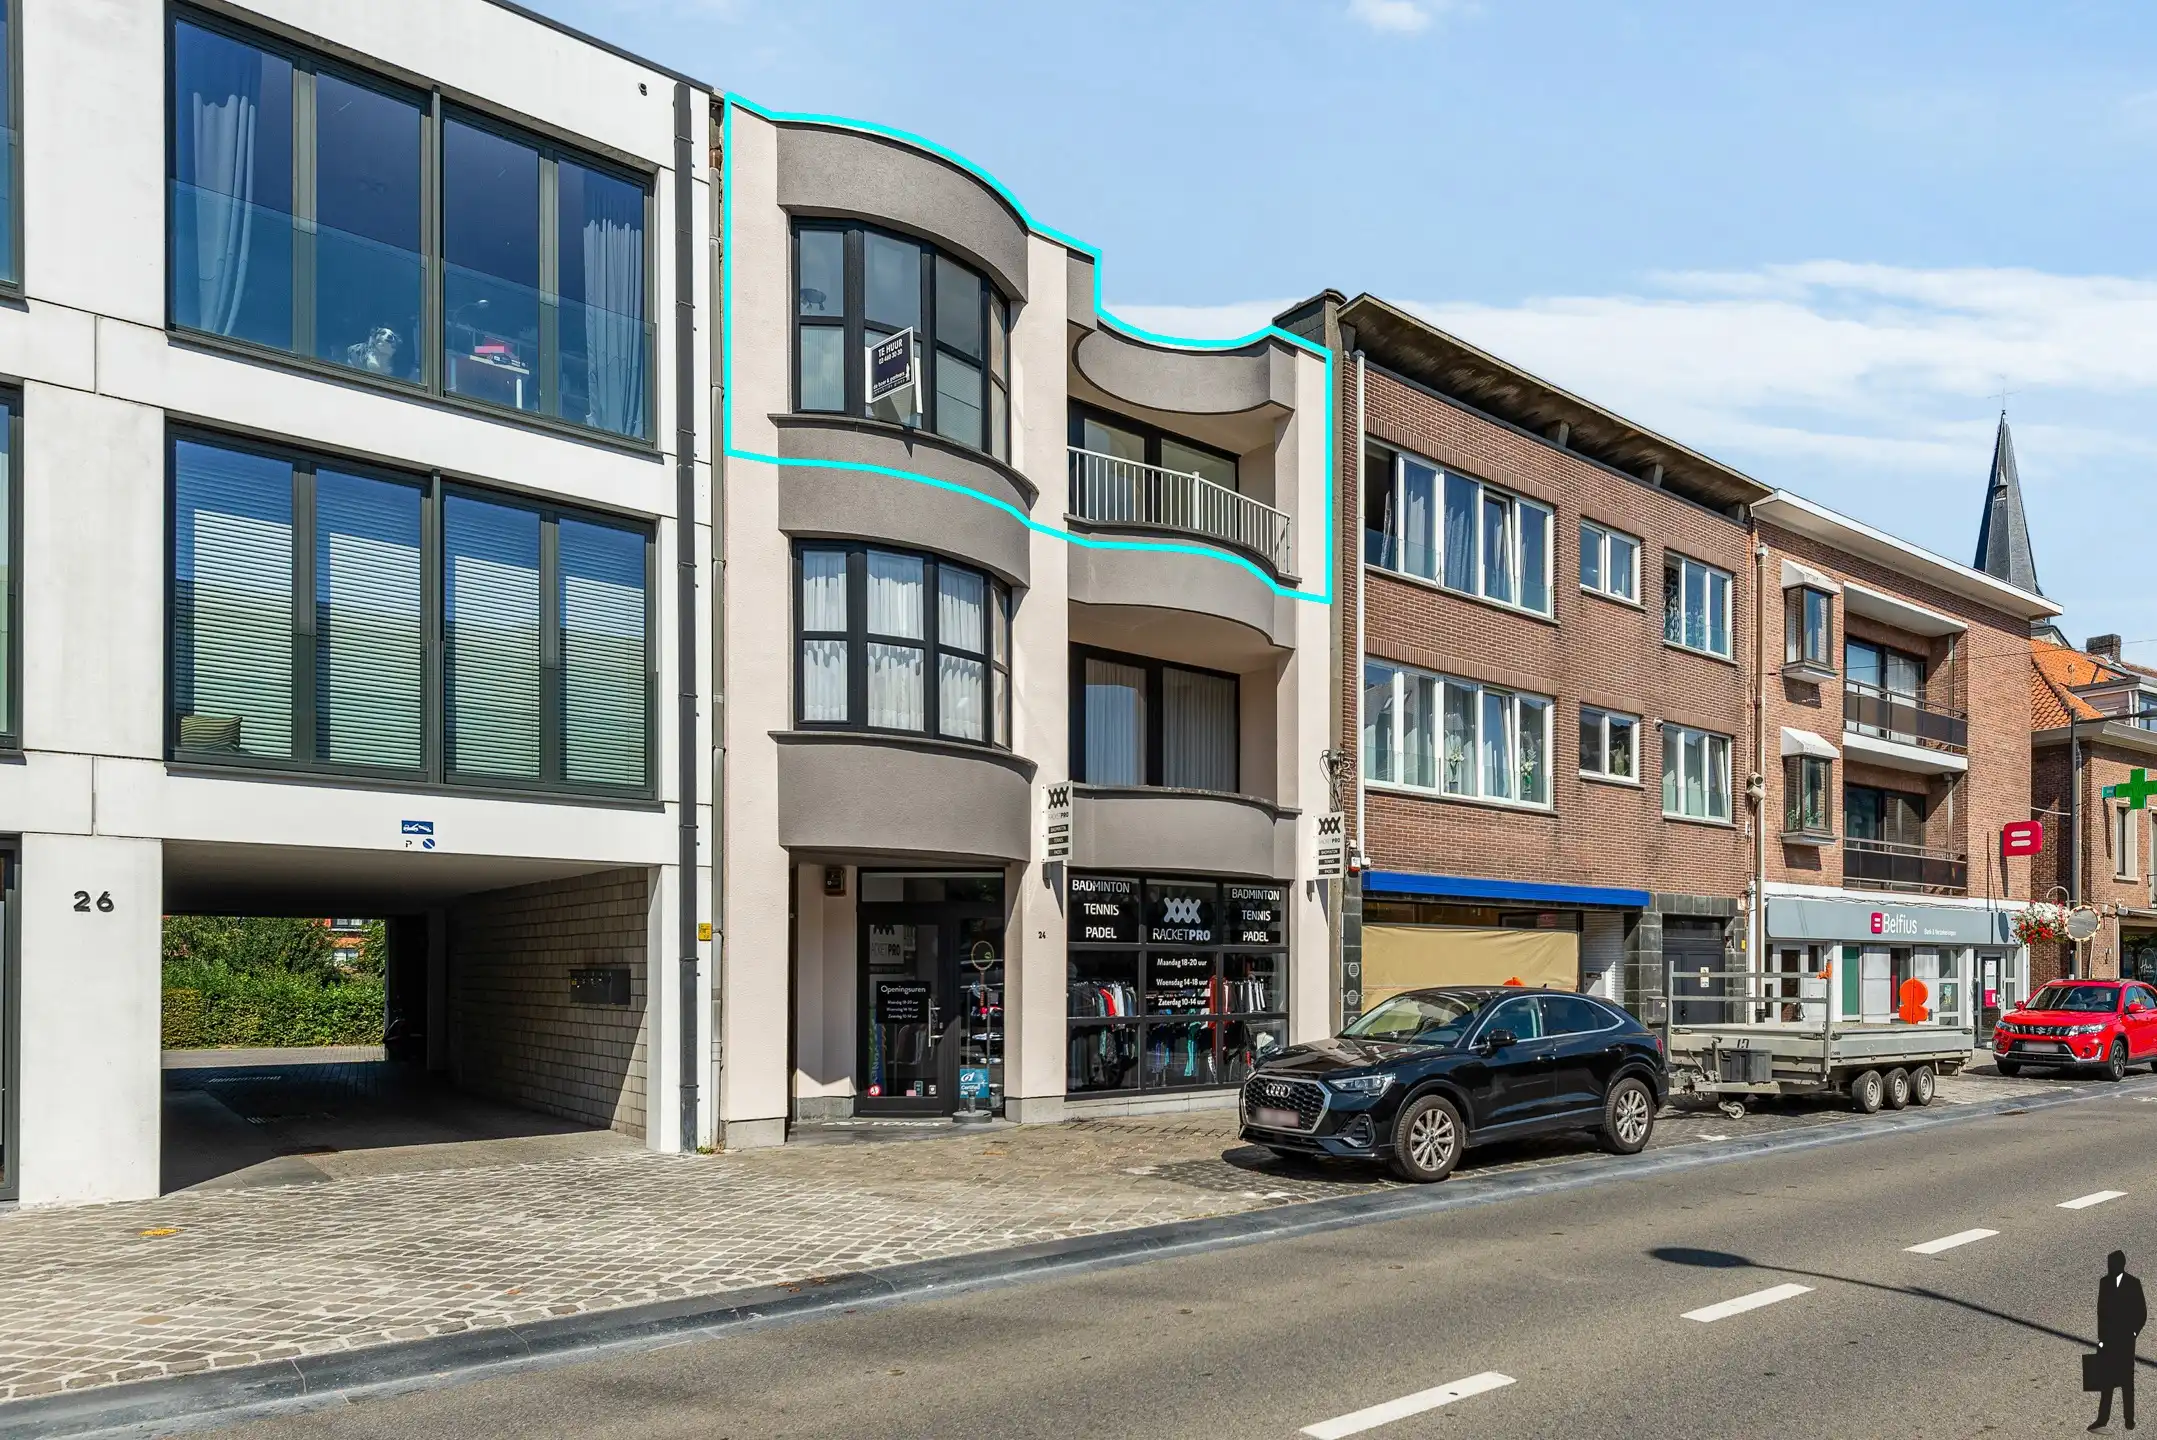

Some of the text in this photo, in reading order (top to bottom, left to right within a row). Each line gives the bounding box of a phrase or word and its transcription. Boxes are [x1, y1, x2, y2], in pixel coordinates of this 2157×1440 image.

[878, 338, 903, 358] TE HUUR
[1072, 879, 1130, 894] BADMINTON
[1231, 888, 1280, 901] BADMINTON
[73, 890, 115, 913] 26
[1083, 902, 1120, 916] TENNIS
[1241, 909, 1272, 922] TENNIS
[1883, 912, 1918, 935] Belfius
[1037, 931, 1046, 939] 24
[1085, 926, 1118, 939] PADEL
[1152, 927, 1211, 942] RACKETPRO
[1242, 930, 1269, 942] PADEL
[1156, 958, 1181, 968] Maandag
[1181, 958, 1198, 966] 18-20
[1156, 978, 1183, 988] Woensdag
[1183, 978, 1198, 986] 14-18
[880, 985, 926, 995] Openingsuren
[1158, 998, 1181, 1008] Zaterdag
[1181, 998, 1197, 1006] 10-14
